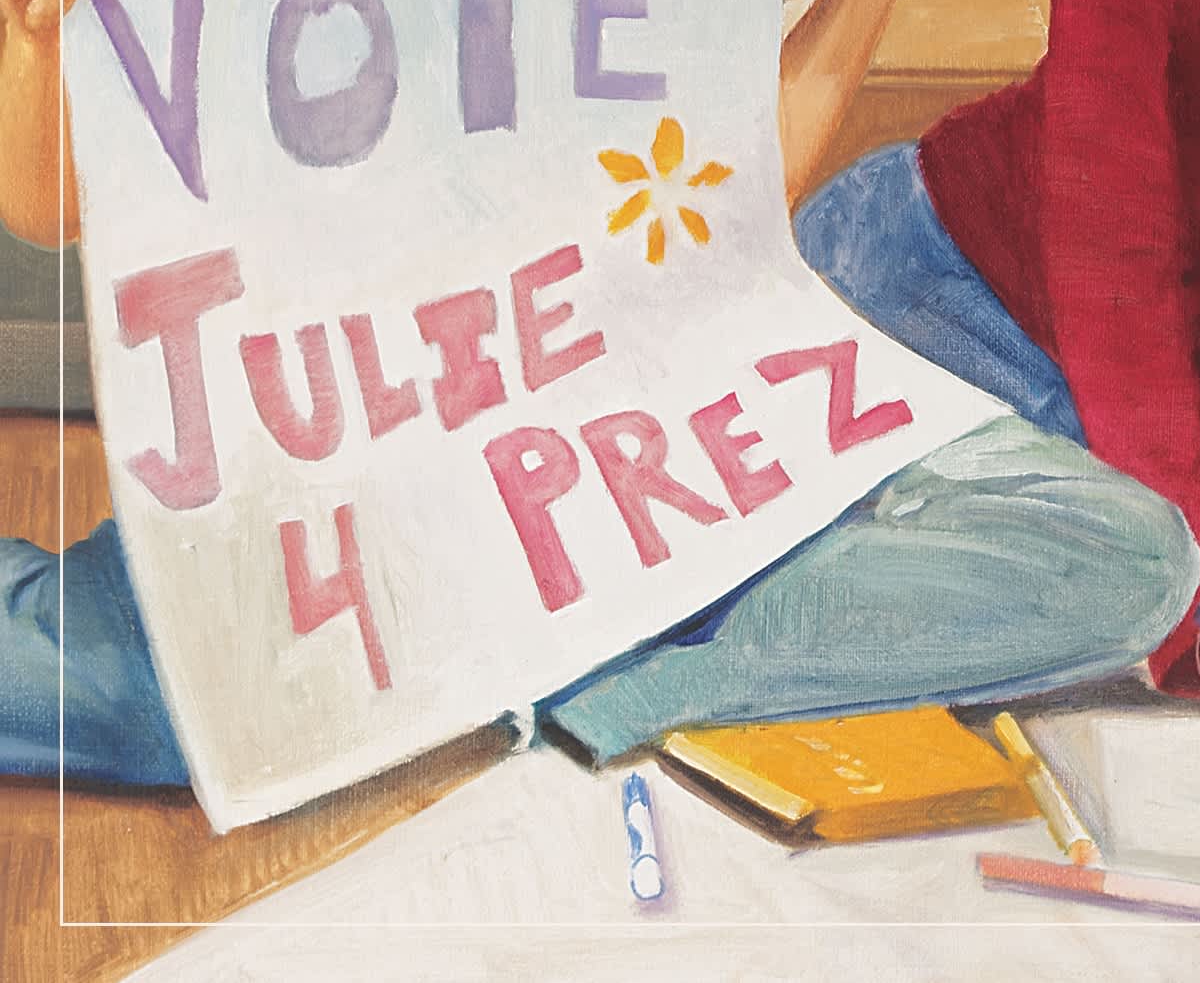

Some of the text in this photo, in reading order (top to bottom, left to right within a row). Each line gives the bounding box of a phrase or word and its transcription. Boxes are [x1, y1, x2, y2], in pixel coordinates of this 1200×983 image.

[112, 244, 606, 511] JULIE
[279, 339, 914, 691] 4 PREZ
